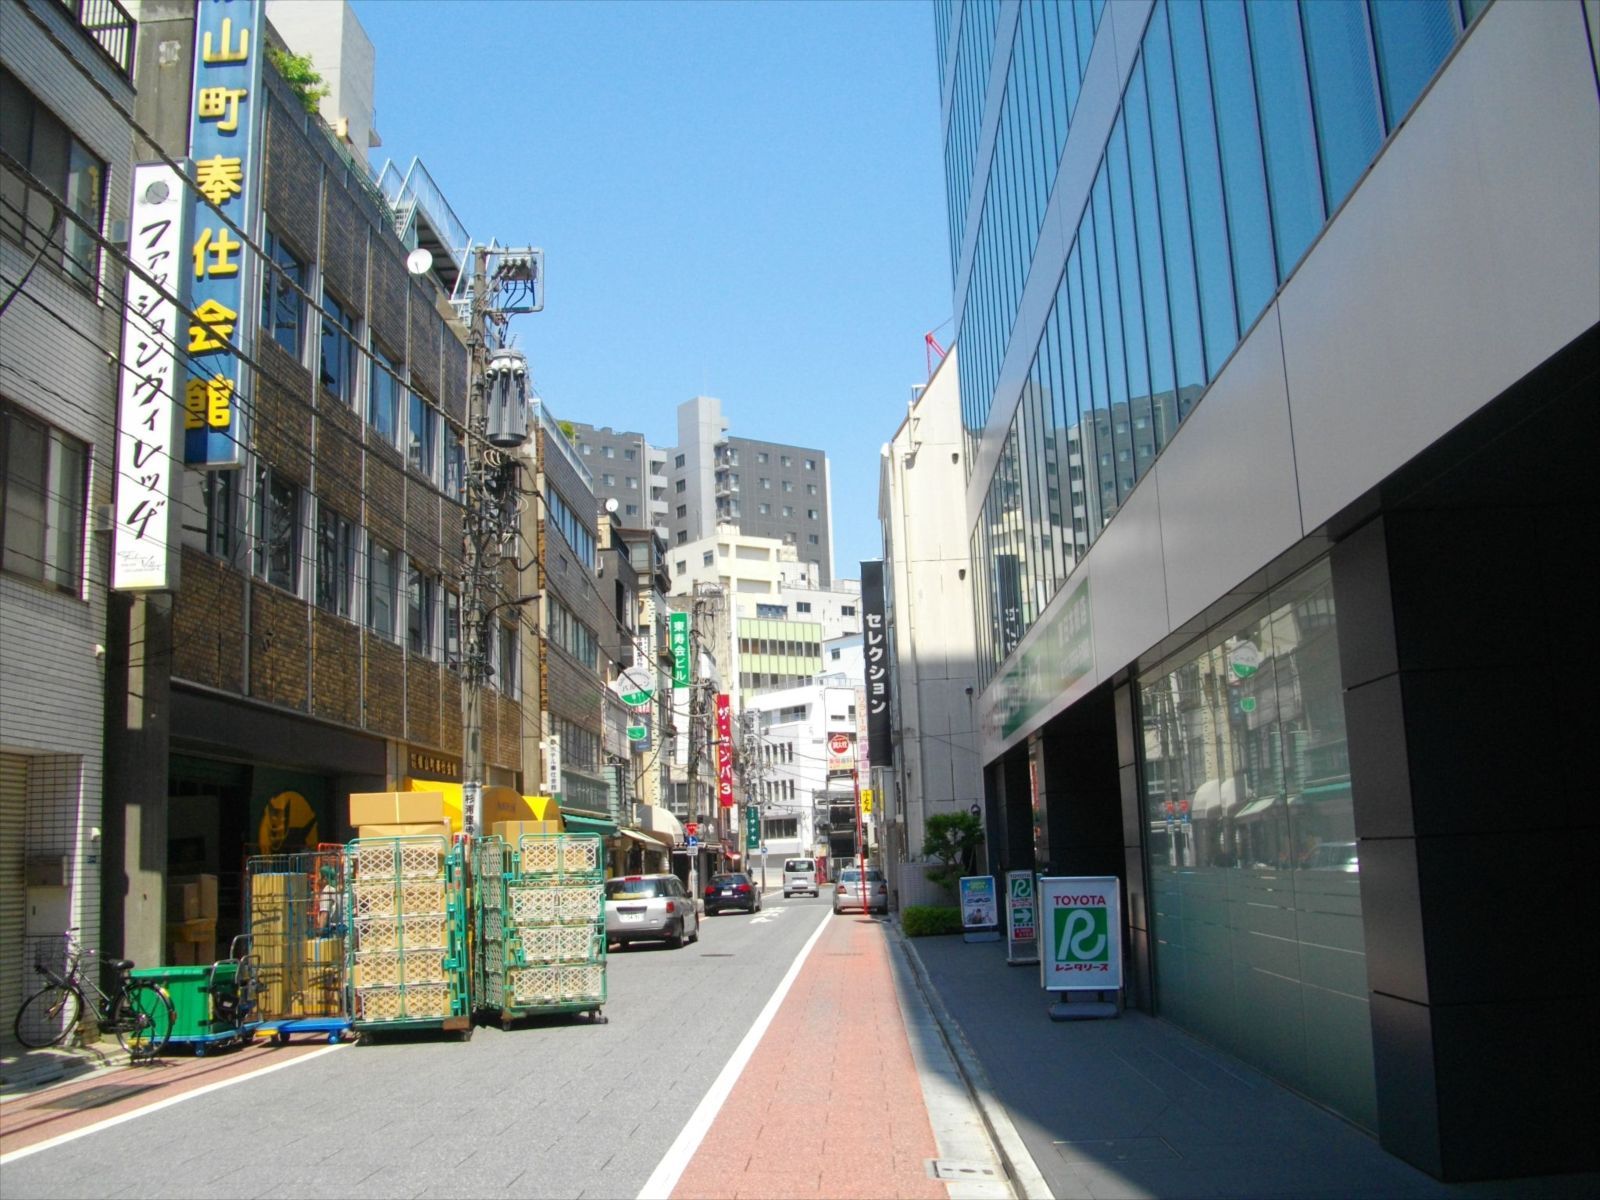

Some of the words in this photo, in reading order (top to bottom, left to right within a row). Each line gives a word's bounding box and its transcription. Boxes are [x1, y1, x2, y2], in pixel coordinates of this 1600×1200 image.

[674, 621, 687, 681] 東寿会ビル
[866, 613, 887, 715] セレクション
[1054, 895, 1106, 906] TOYOTA
[1055, 963, 1108, 972] レンタリース
